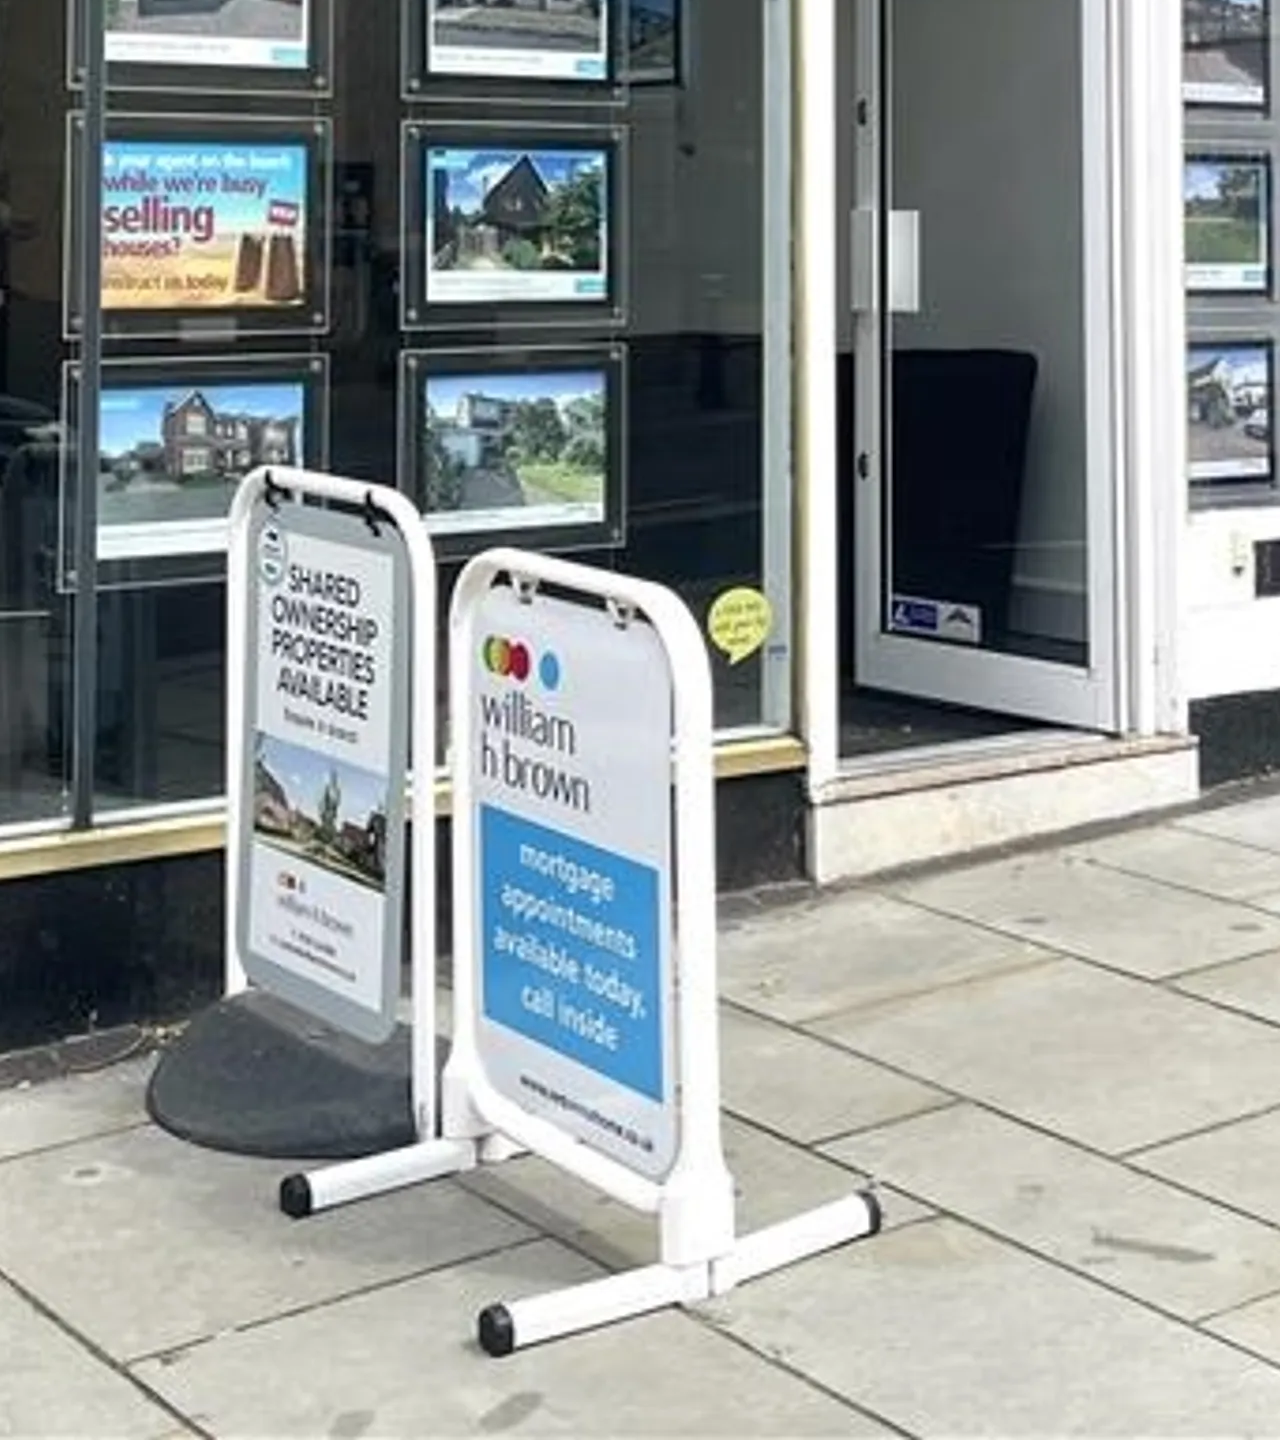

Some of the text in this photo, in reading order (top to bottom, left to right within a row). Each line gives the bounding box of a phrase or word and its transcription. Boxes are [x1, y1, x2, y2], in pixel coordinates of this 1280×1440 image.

[103, 170, 268, 197] while we're busy
[103, 237, 180, 256] houses?
[104, 196, 214, 243] selling
[288, 563, 360, 609] SHARED
[272, 594, 379, 646] OWNERSHIP
[272, 628, 375, 685] PROPERTIES
[277, 666, 368, 721] AVAILABLE
[481, 689, 574, 755] william
[481, 731, 589, 811] h brown
[520, 843, 615, 904] mortgage
[500, 882, 637, 960] appointments
[493, 925, 647, 1019] available today,
[521, 985, 620, 1052] call inside
